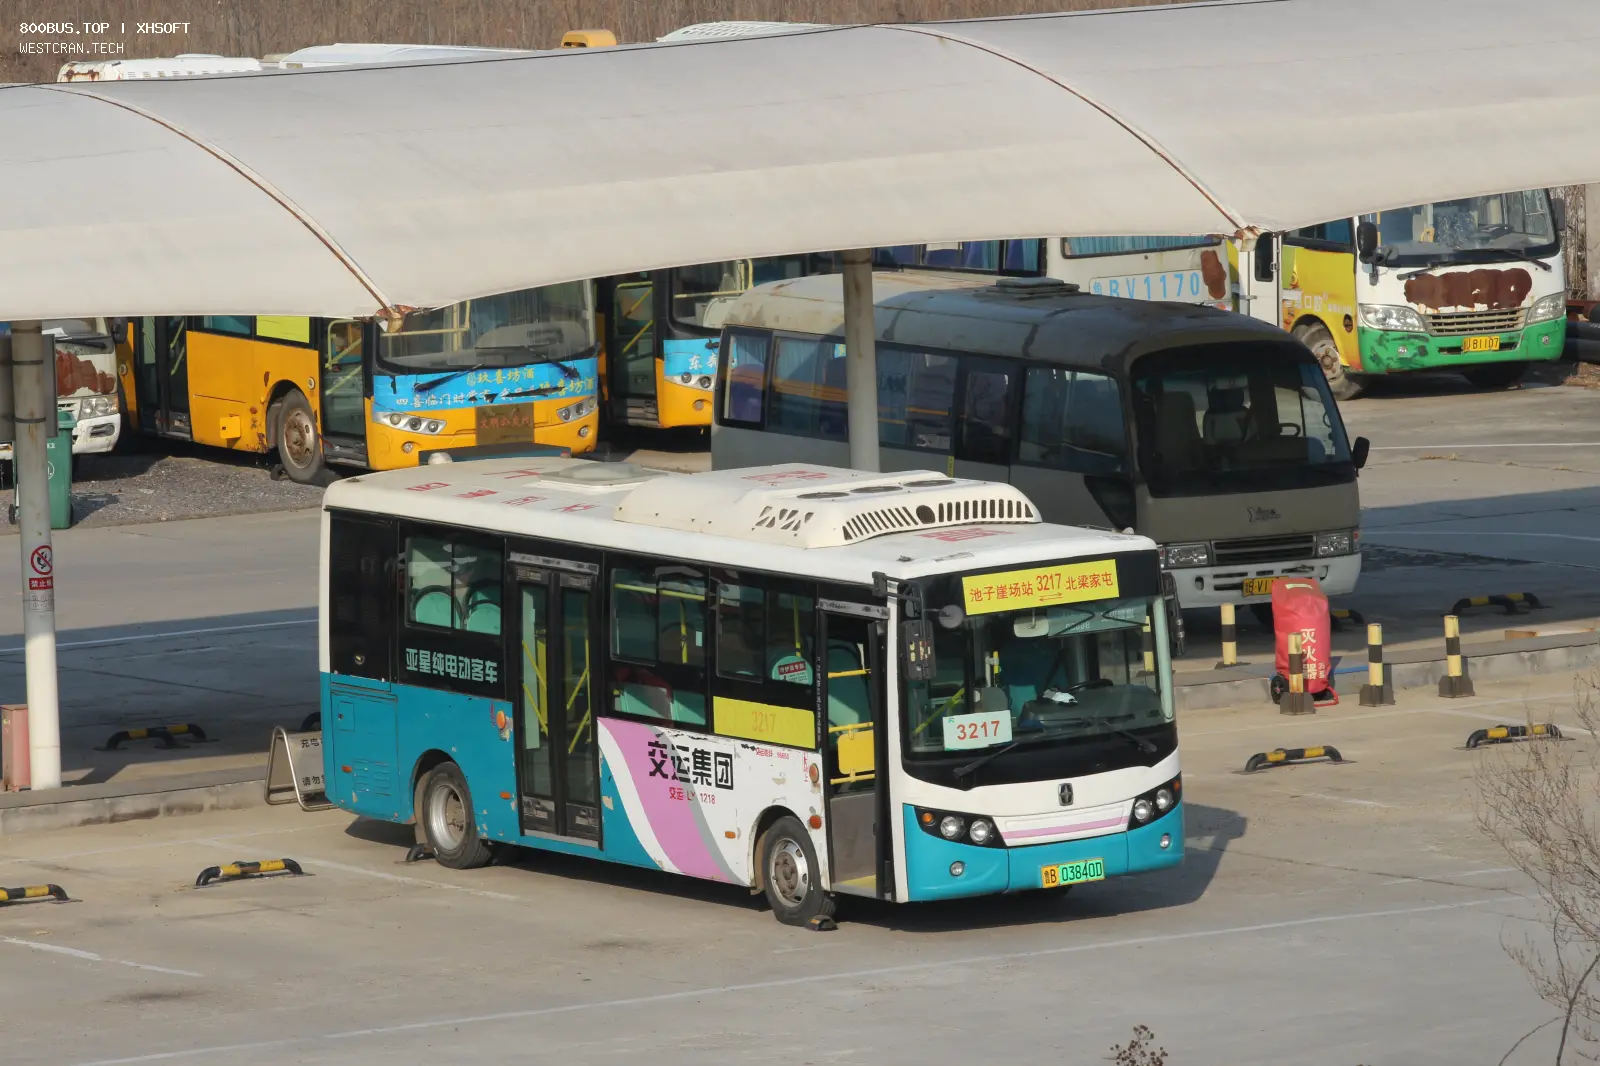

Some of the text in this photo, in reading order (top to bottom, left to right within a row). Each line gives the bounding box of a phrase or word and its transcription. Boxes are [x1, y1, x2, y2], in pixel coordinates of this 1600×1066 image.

[970, 571, 1114, 603] 池子崖场站 3217 北梁家屯
[405, 647, 498, 684] 亚星纯电动客车
[1300, 628, 1318, 680] 灭火器
[751, 710, 776, 734] 3217
[956, 720, 1000, 741] 3217
[300, 738, 323, 749] 充电
[647, 740, 734, 791] 交运集团
[669, 787, 684, 802] 交运
[699, 792, 716, 805] 1218
[1061, 861, 1103, 882] 03840D
